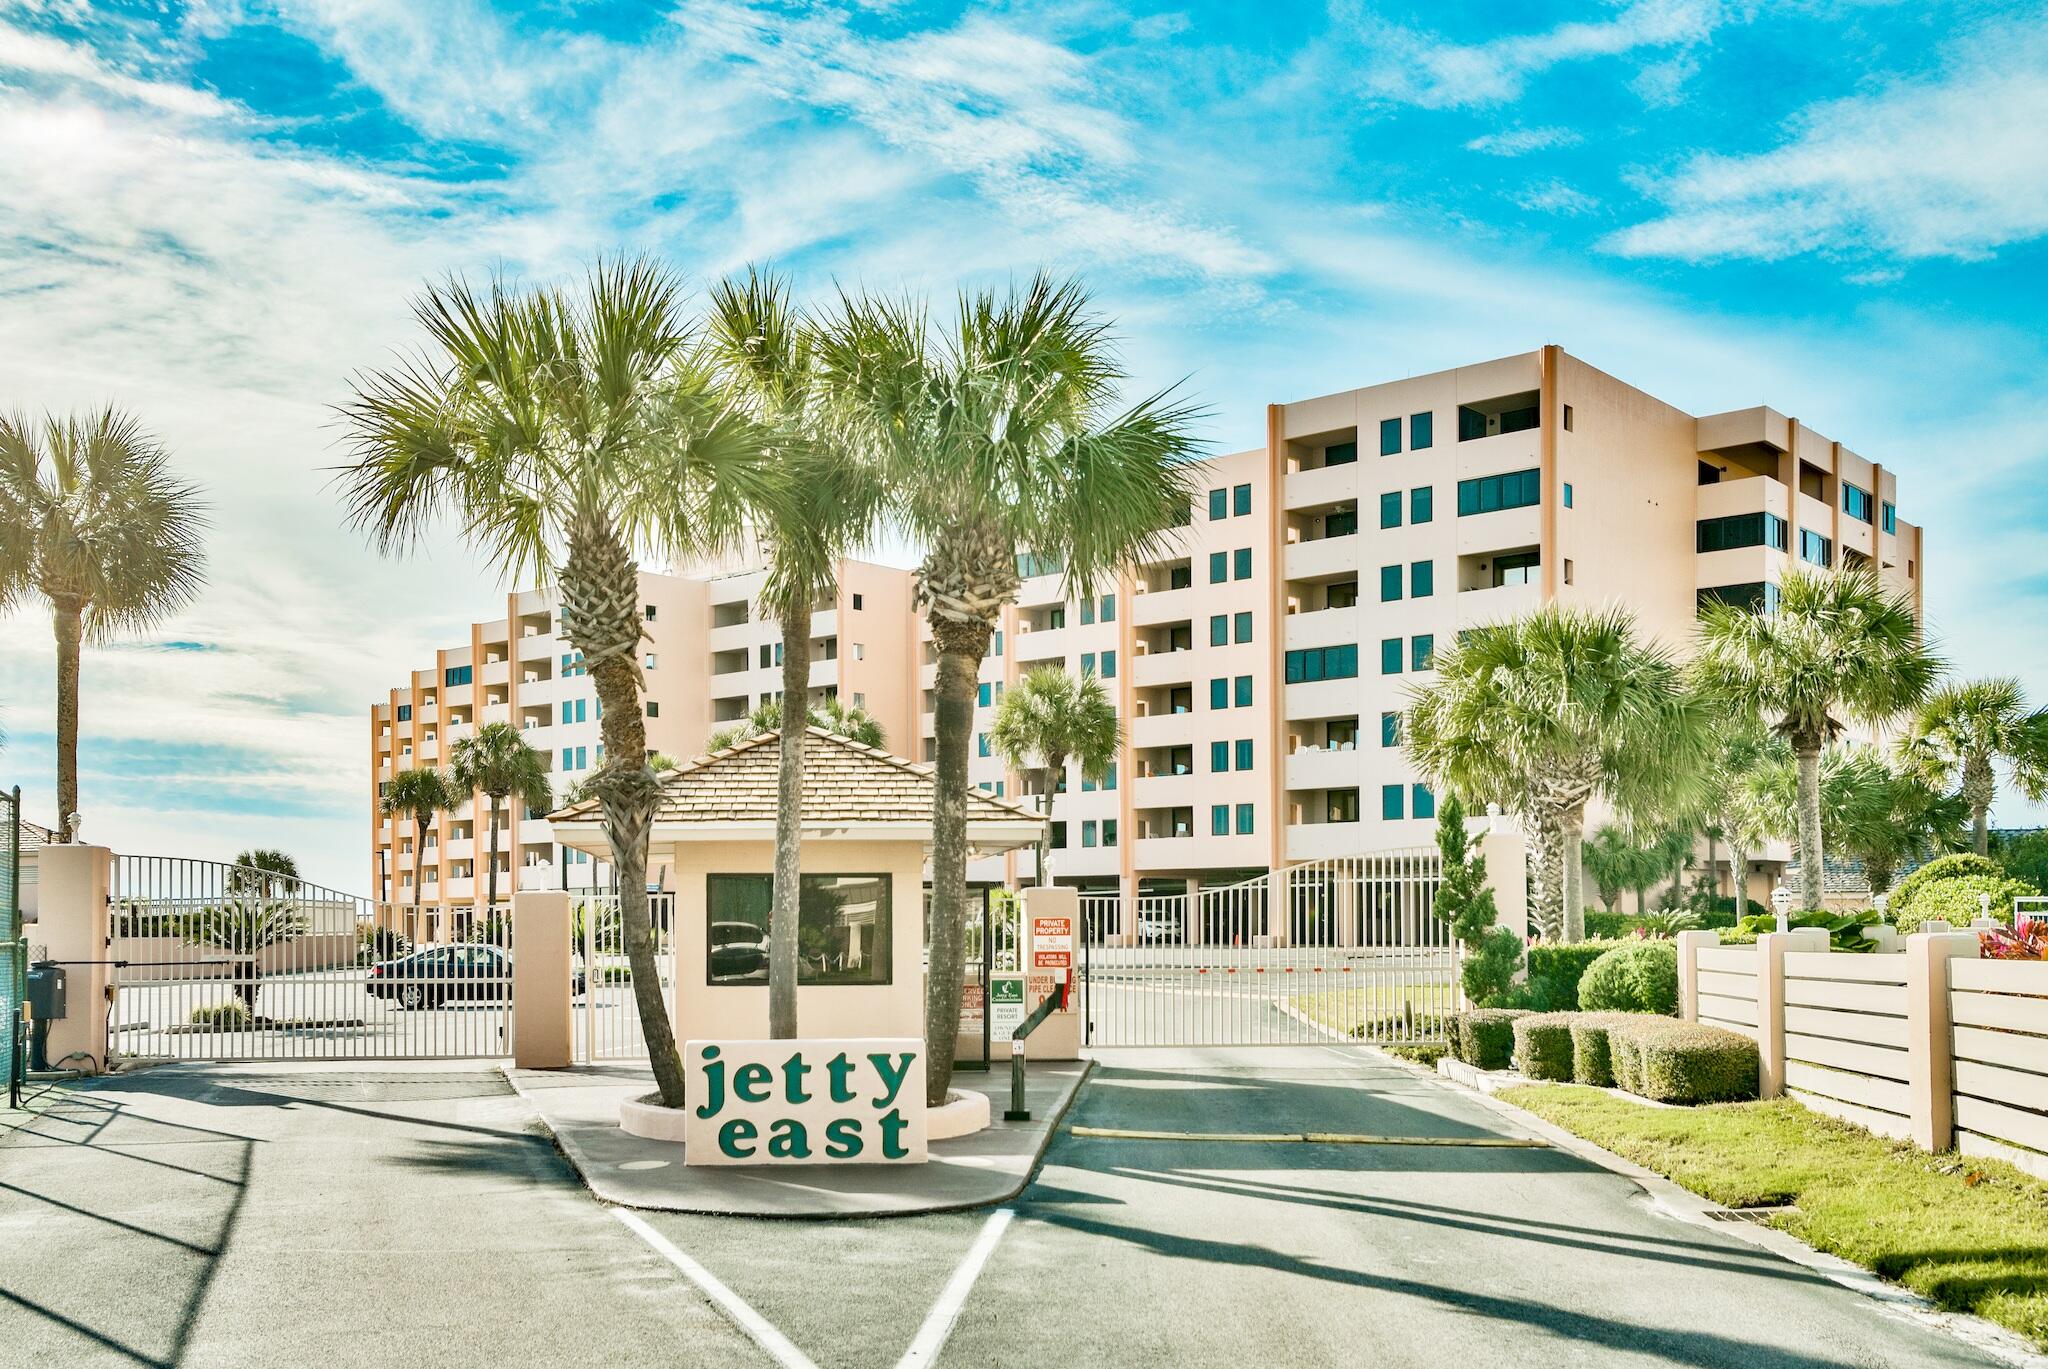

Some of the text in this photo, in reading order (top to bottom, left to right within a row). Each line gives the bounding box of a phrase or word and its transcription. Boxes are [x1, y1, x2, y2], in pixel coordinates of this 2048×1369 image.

[1039, 919, 1065, 927] PRIVATE
[1036, 927, 1069, 935] PROPERTY
[1028, 976, 1048, 984] UNDER
[1028, 985, 1042, 993] PIPE
[696, 1045, 917, 1120] jetty
[718, 1108, 910, 1159] east
